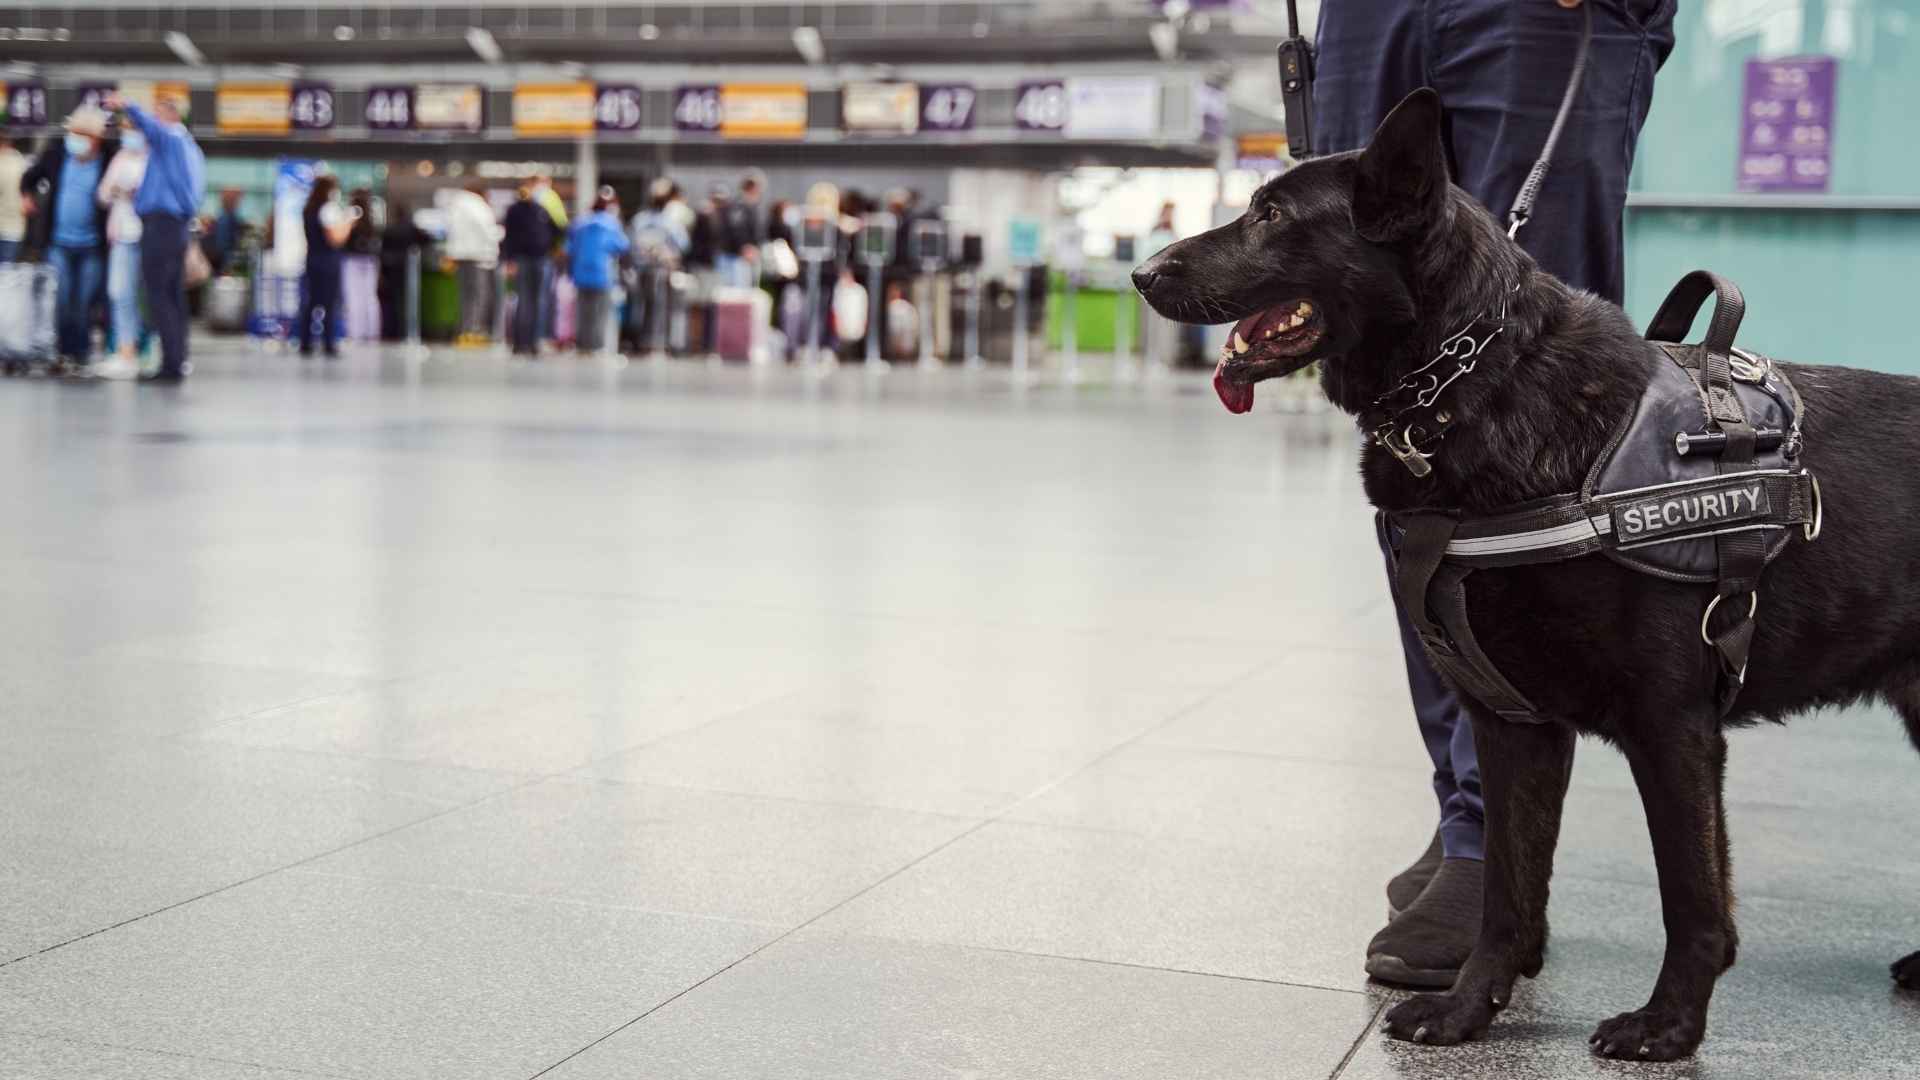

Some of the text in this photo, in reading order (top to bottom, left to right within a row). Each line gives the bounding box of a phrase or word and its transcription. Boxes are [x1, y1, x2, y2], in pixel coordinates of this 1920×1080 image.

[291, 89, 334, 126] 43
[366, 89, 408, 123] 44
[597, 89, 640, 127] 45
[675, 88, 721, 127] 46
[925, 88, 975, 128] 47
[1016, 86, 1065, 127] 48
[1624, 487, 1760, 533] SECURITY
